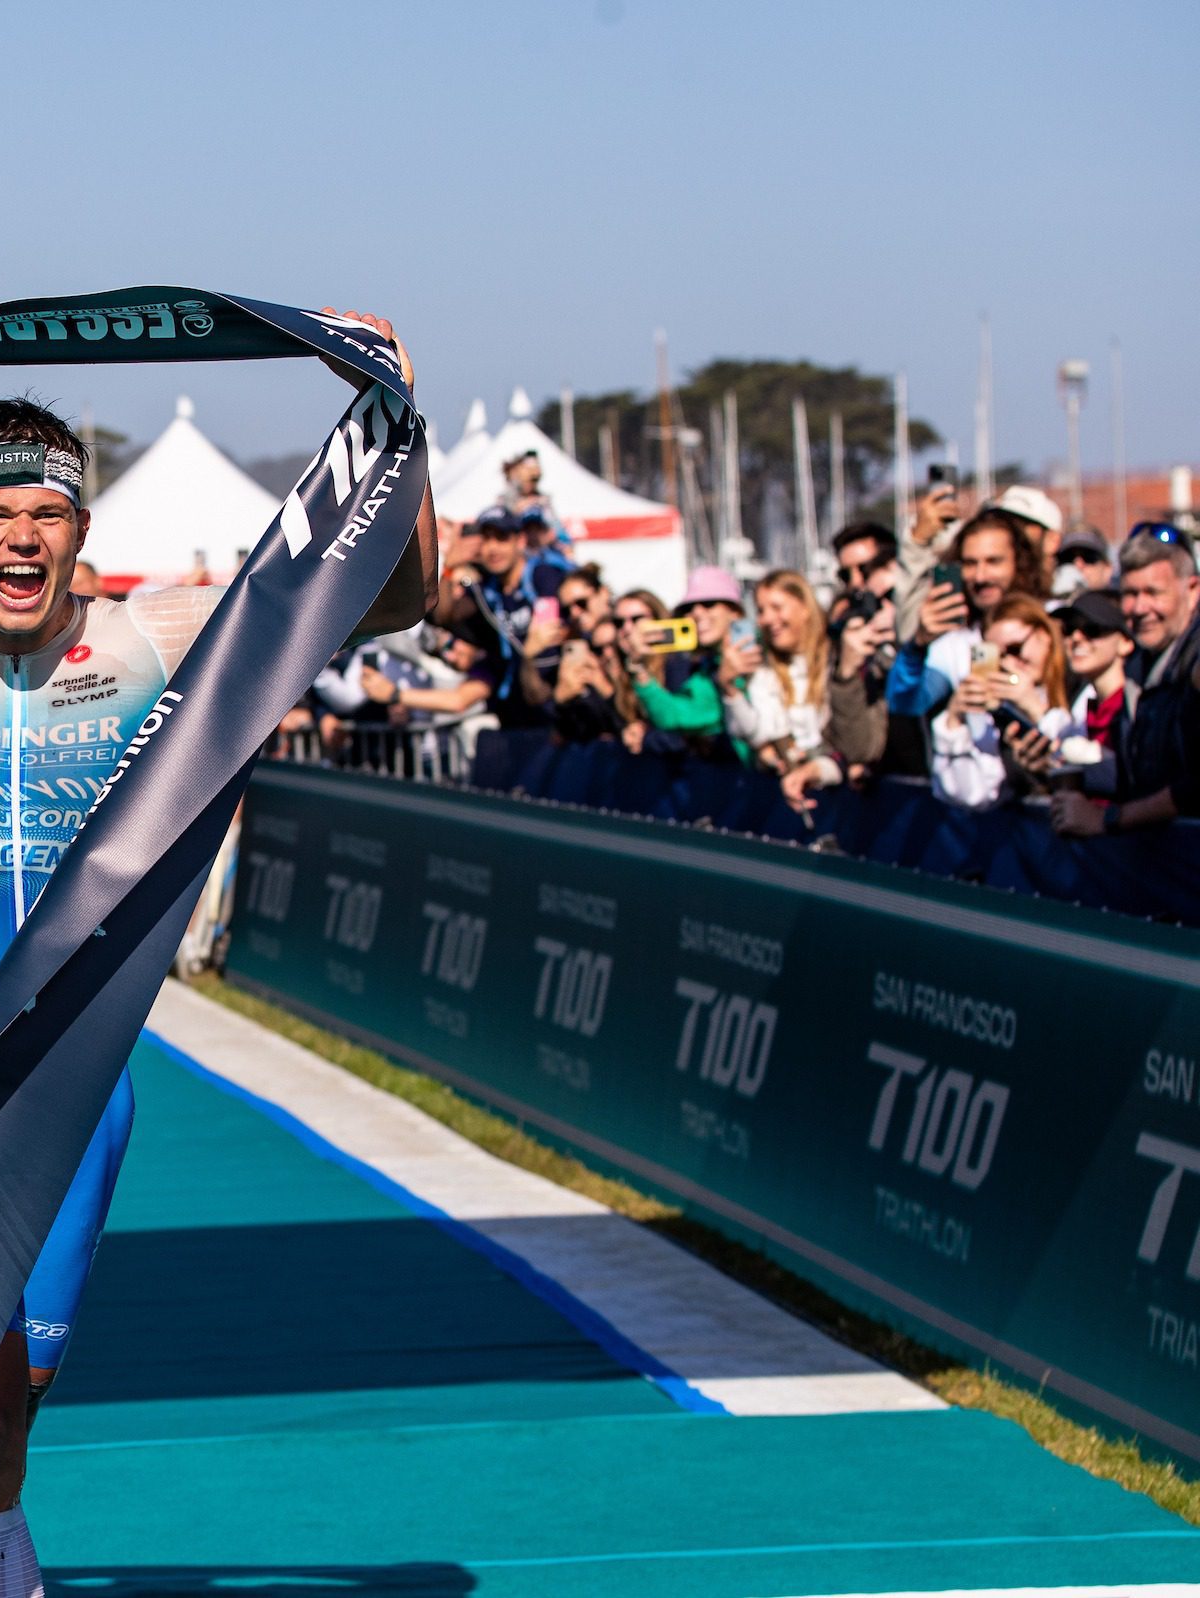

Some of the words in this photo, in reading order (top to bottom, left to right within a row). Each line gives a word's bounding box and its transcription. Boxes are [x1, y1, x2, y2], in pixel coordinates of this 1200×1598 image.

[321, 324, 406, 382] TRIAT
[51, 688, 118, 708] OLYMP
[52, 673, 98, 688] schnelle
[65, 676, 116, 693] Stelle.de
[534, 936, 613, 1037] T100
[874, 972, 909, 1015] SAN
[913, 983, 1017, 1049] FRANCISCO
[676, 977, 778, 1098] T100
[1144, 1048, 1194, 1103] SAN
[867, 1040, 1011, 1192] T100
[1148, 1305, 1200, 1369] TRIA
